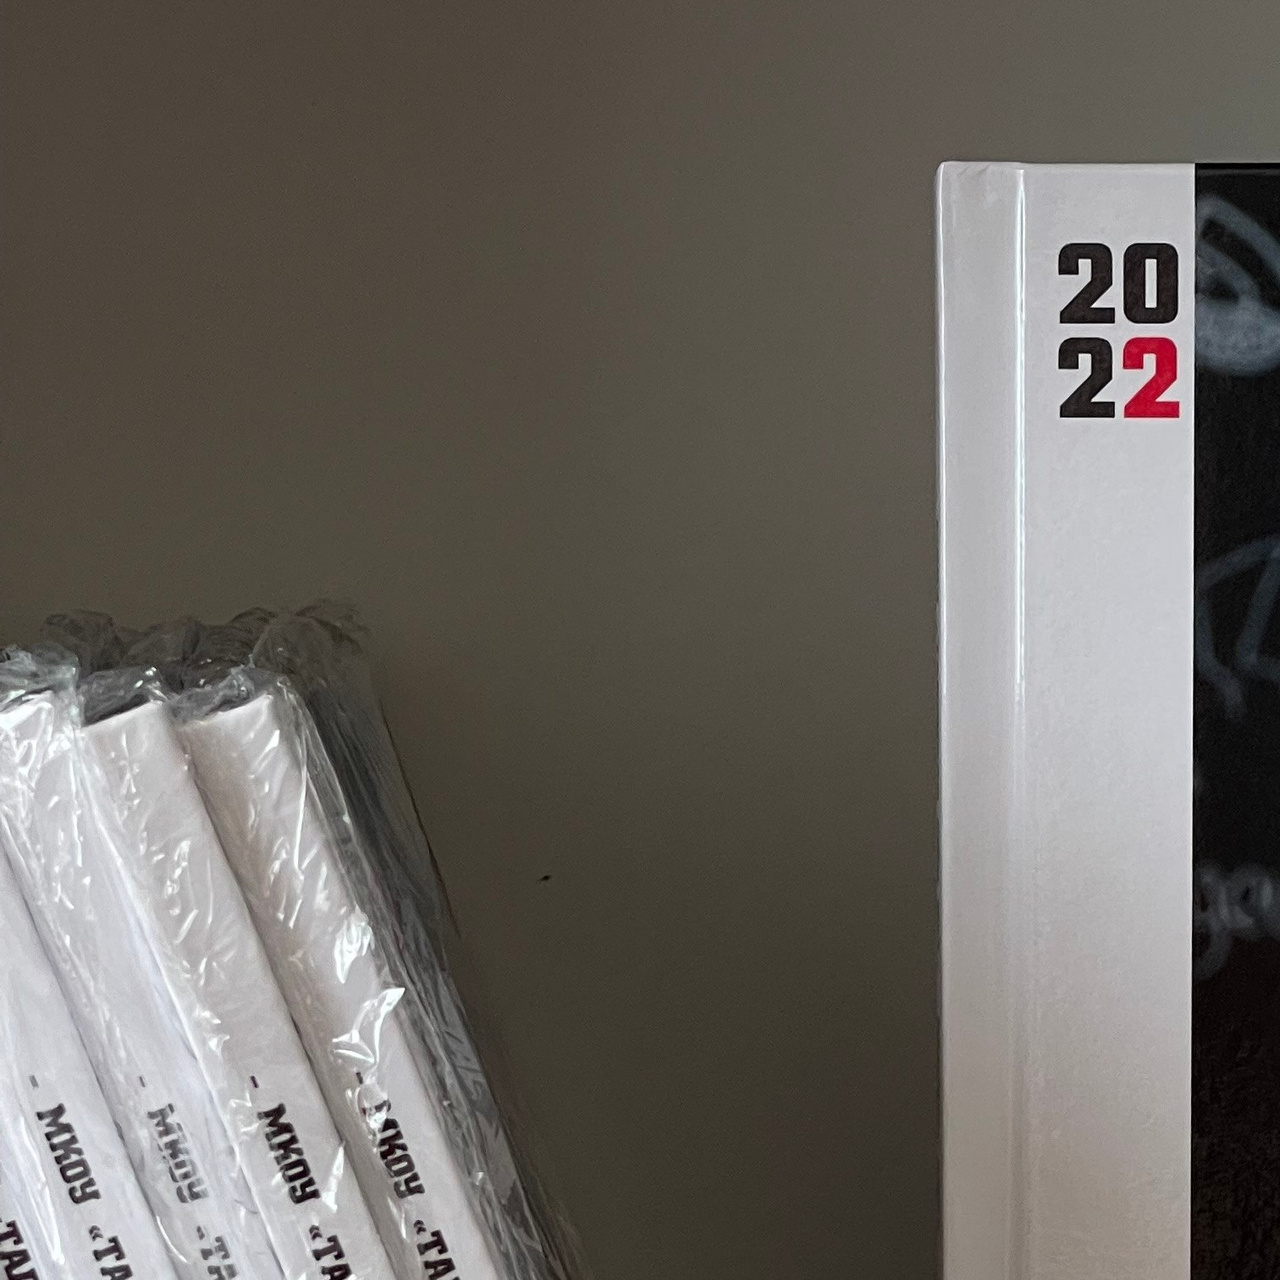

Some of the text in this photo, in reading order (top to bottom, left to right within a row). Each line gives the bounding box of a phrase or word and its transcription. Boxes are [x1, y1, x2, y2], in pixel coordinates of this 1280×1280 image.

[1058, 242, 1179, 324] 20
[1058, 337, 1180, 419] 22
[37, 1104, 101, 1204] МКОУ
[257, 1103, 320, 1204] МКОУ
